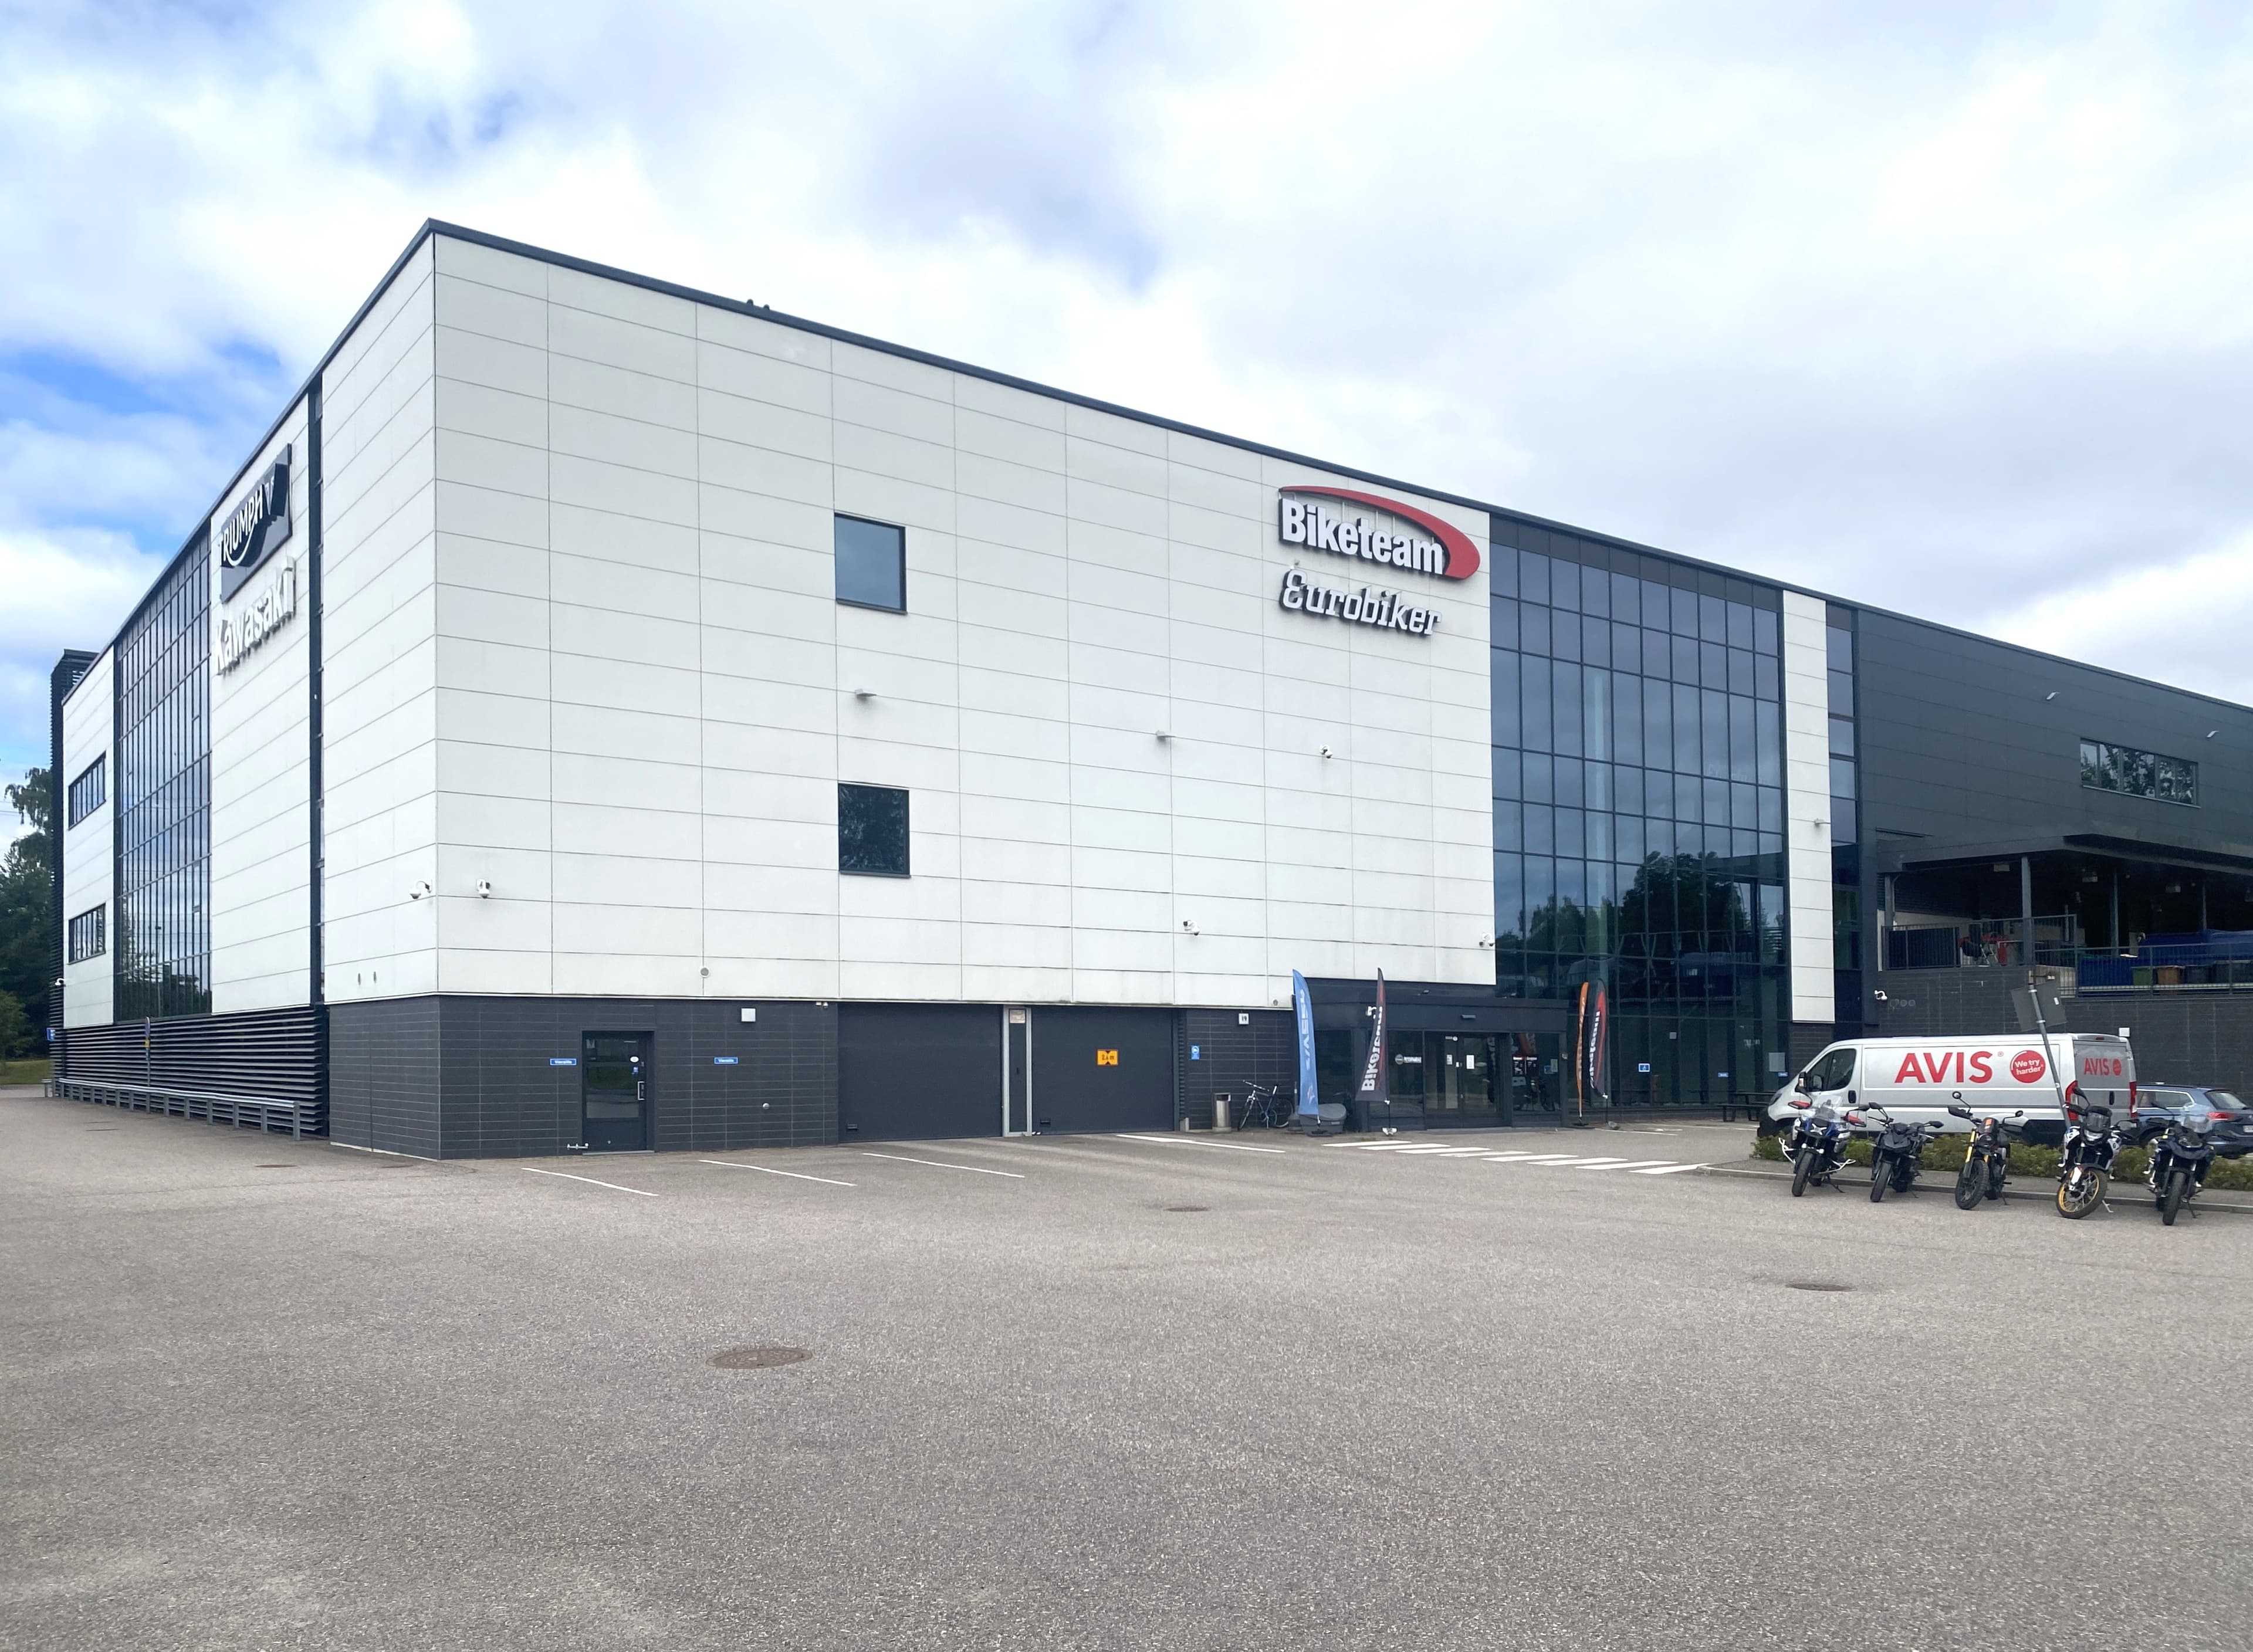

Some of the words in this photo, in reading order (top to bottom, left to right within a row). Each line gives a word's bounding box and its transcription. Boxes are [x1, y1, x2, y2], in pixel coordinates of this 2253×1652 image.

[220, 484, 263, 566] TRIUMPH
[1280, 498, 1443, 575] Biketeam
[215, 557, 292, 675] Kawasaki
[1281, 570, 1442, 636] Eurobiker
[1895, 1051, 1993, 1084] AVIS
[2016, 1066, 2041, 1075] harder
[2084, 1058, 2109, 1075] AVIS
